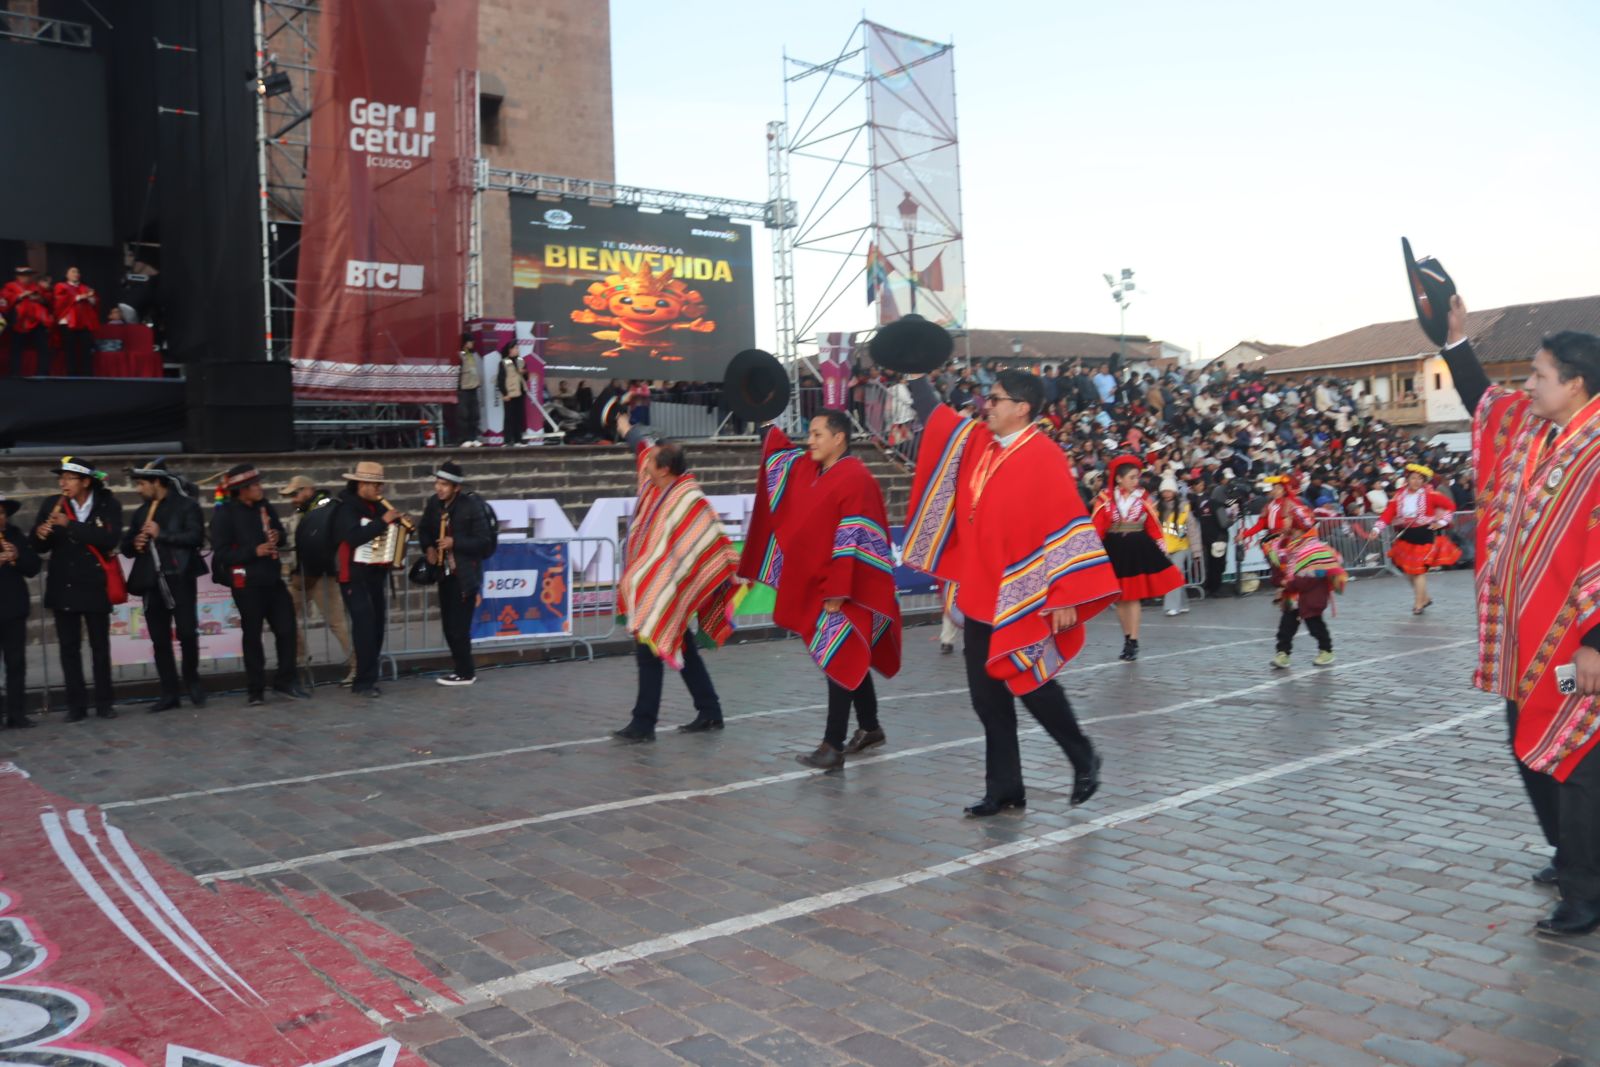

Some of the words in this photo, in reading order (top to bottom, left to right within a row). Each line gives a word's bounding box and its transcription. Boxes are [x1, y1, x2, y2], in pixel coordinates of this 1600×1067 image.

[350, 127, 436, 157] cetur
[602, 240, 616, 249] TE
[618, 242, 667, 255] DAMOS
[669, 246, 685, 256] LA
[544, 244, 734, 283] BIENVENIDA
[496, 578, 521, 590] BCP
